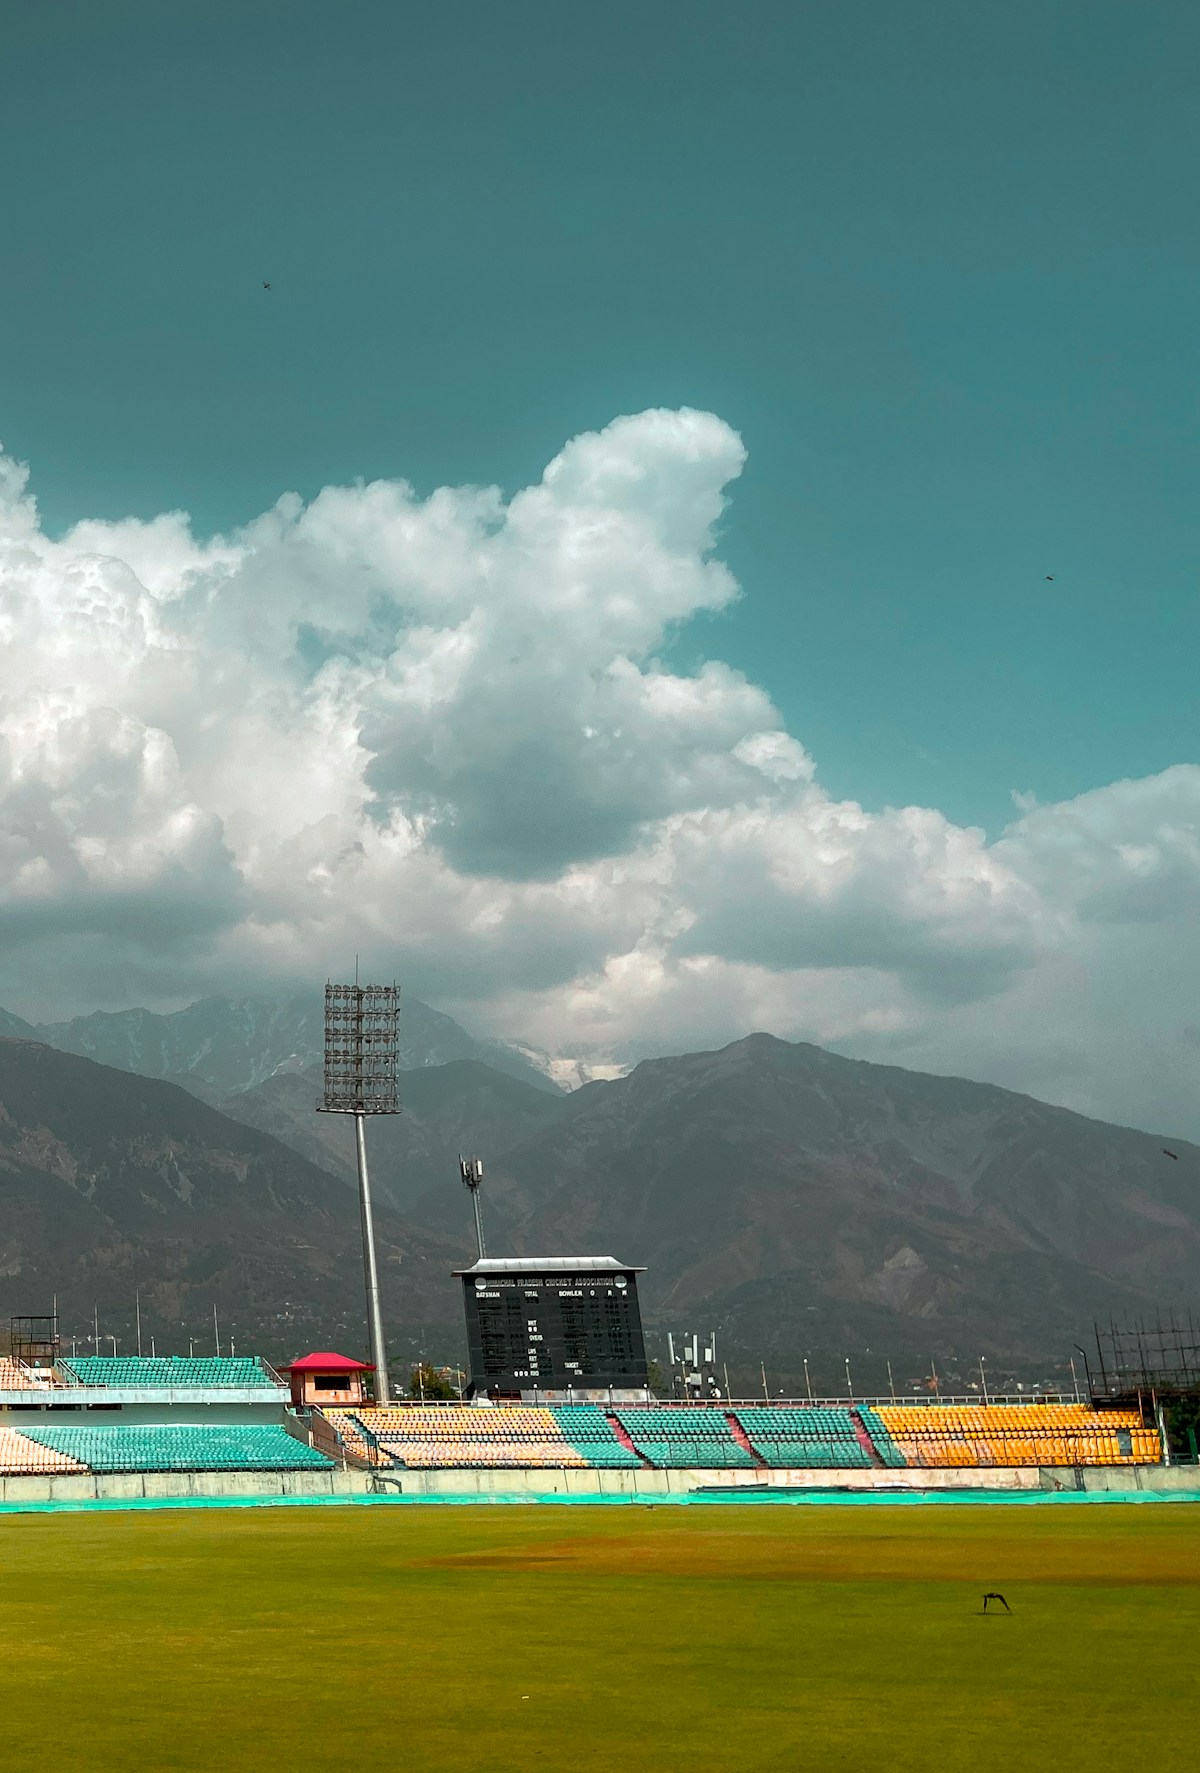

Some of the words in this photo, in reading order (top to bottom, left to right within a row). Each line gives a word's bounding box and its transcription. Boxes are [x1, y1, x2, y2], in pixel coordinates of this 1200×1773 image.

[545, 1278, 573, 1287] CRICKET
[574, 1277, 614, 1287] ASSOCIATION
[558, 1289, 583, 1297] BOWLER
